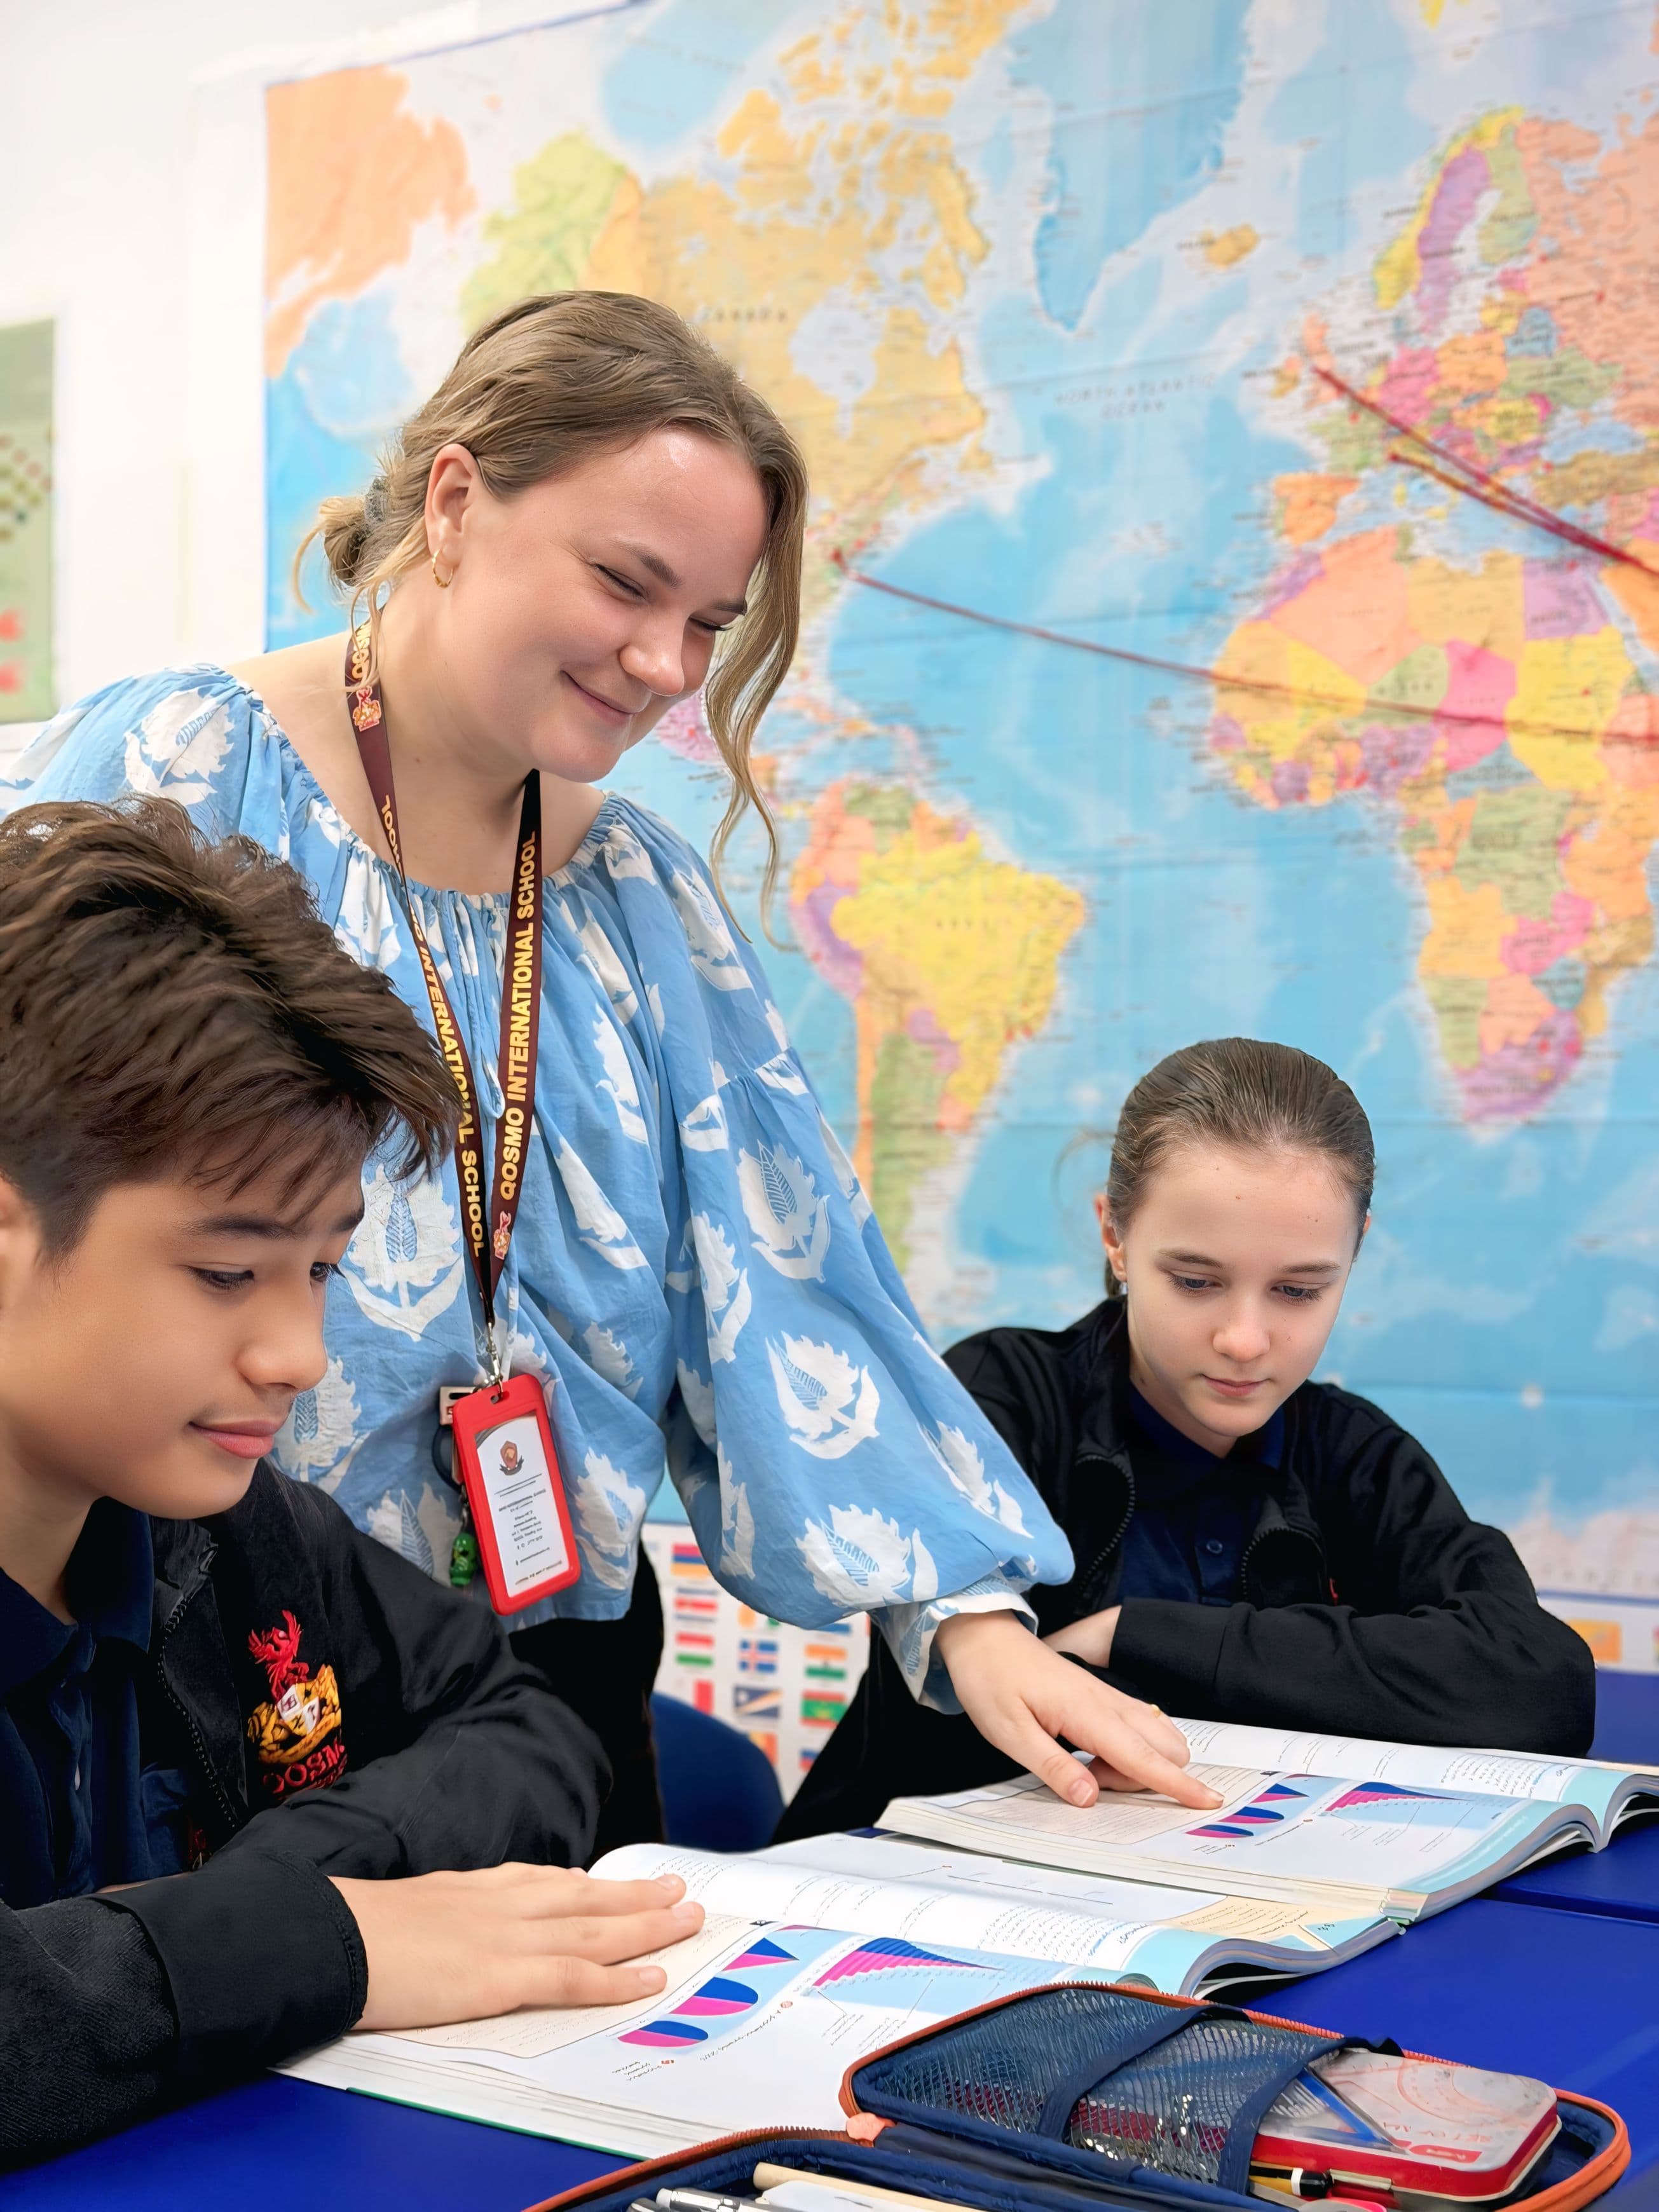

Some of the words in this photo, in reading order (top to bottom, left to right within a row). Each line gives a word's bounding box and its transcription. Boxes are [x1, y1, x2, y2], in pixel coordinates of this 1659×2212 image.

[516, 830, 535, 920] SCHOOL
[506, 922, 535, 1102] INTERNATIONAL
[461, 1149, 484, 1257] SCHOOL
[500, 1107, 524, 1201] QOSMO
